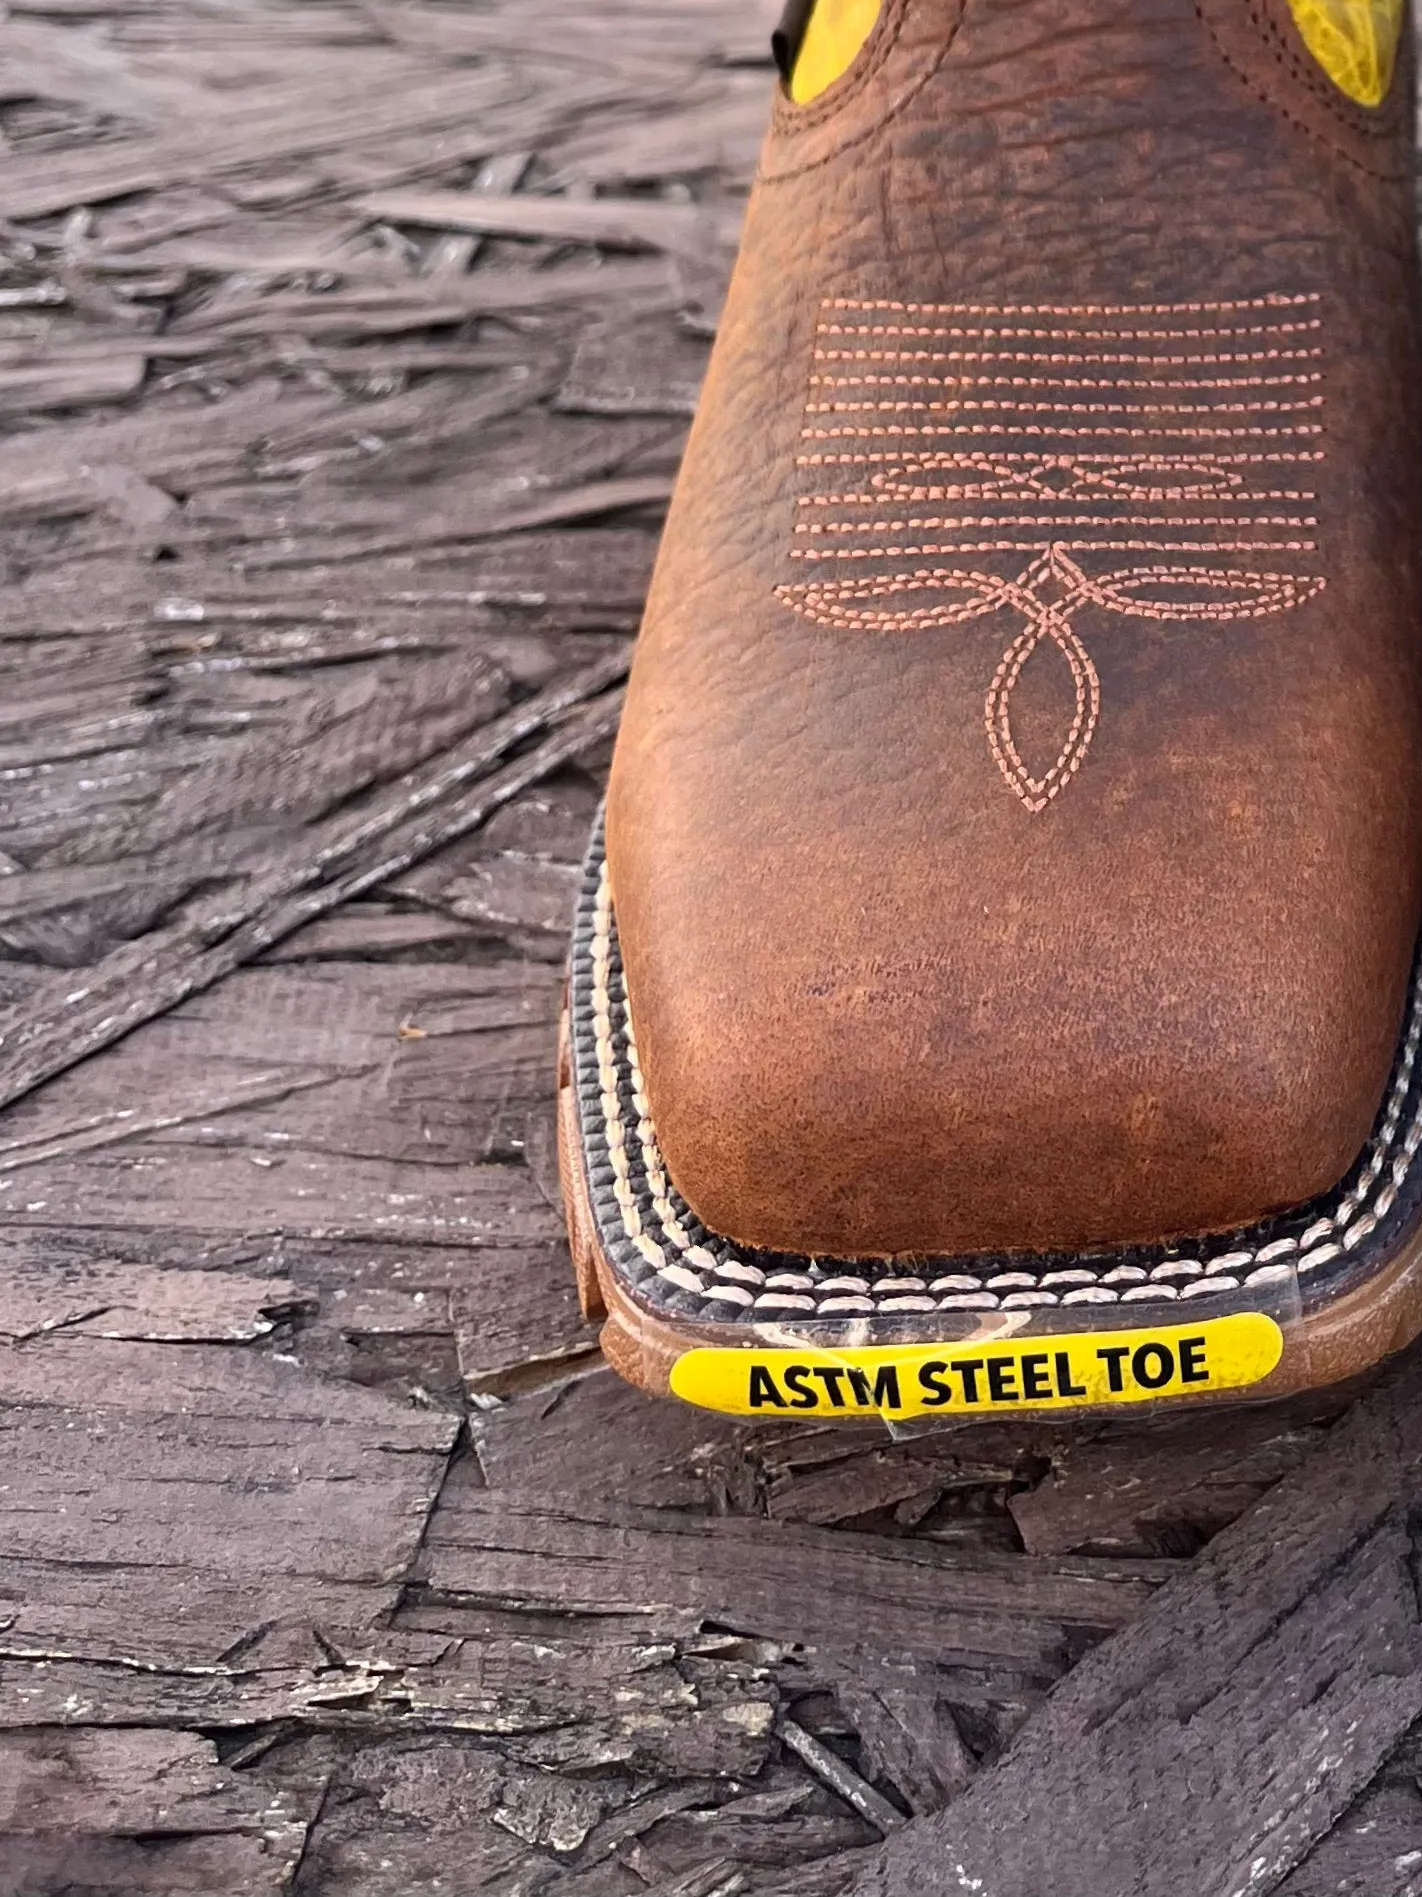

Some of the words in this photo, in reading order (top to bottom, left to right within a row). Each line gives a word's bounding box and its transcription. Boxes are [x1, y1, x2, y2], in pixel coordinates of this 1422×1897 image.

[748, 1364, 900, 1410] ASTM
[918, 1351, 1087, 1405] STEEL
[1097, 1336, 1211, 1393] TOE
